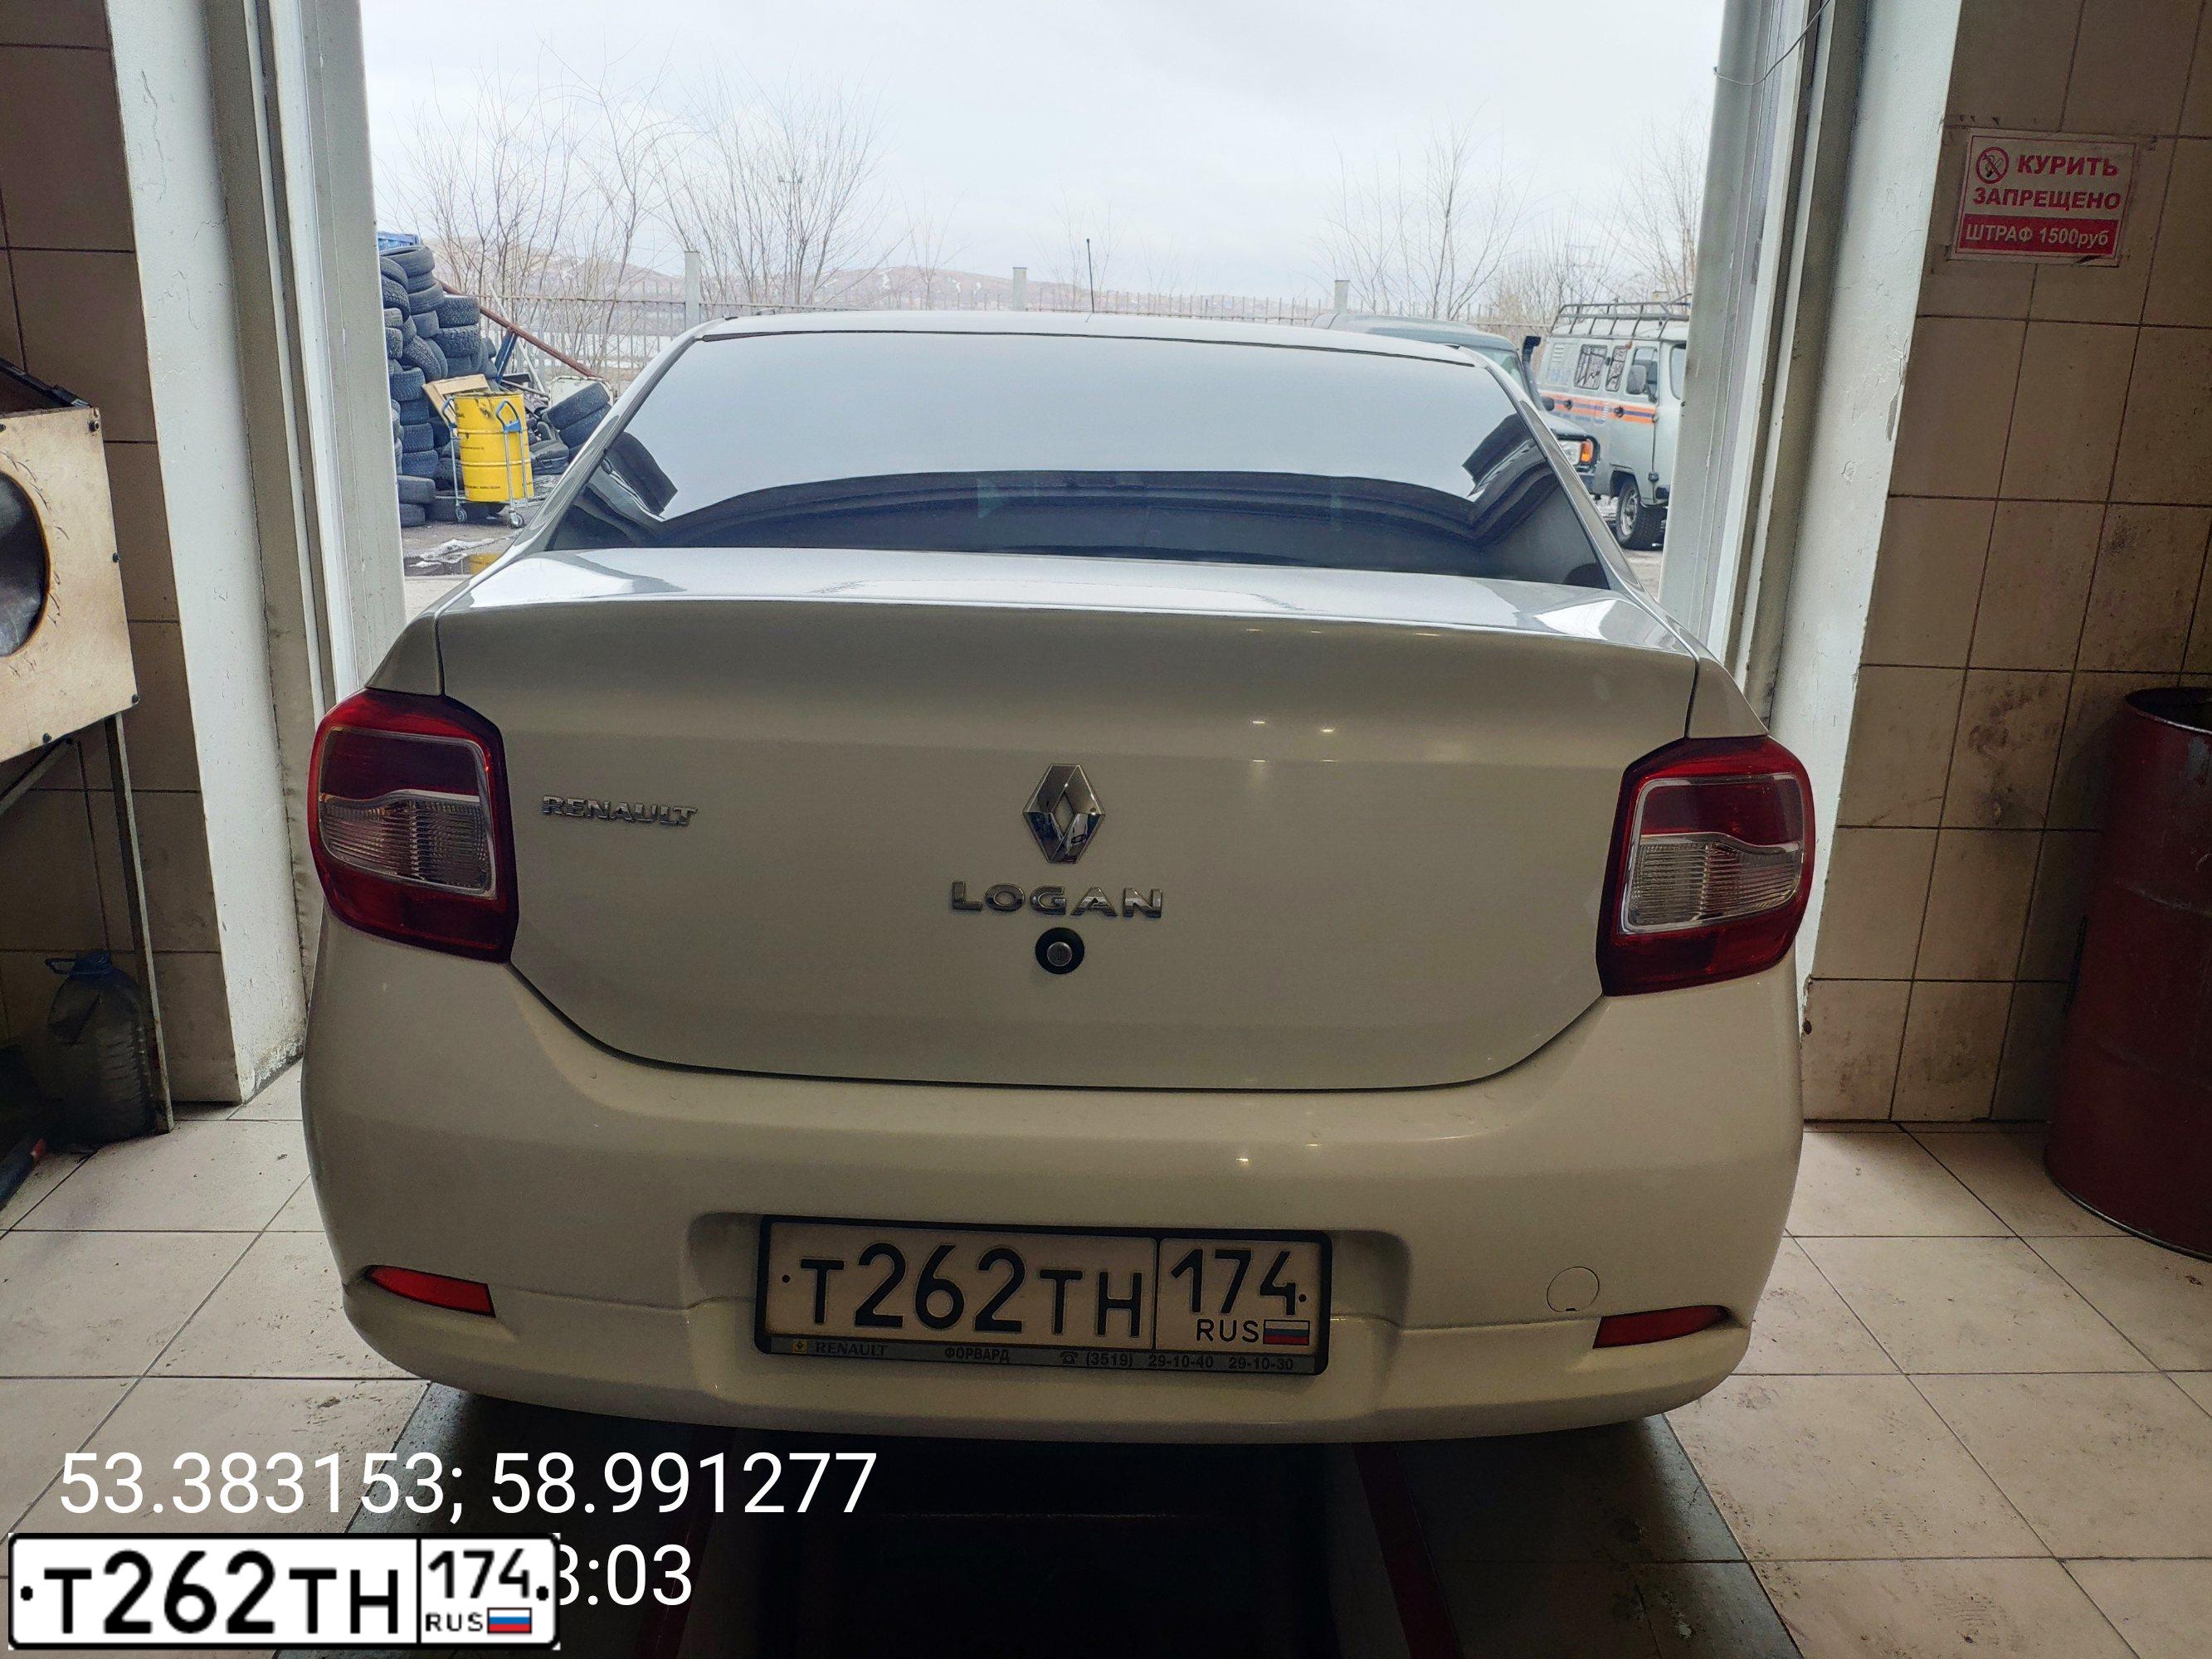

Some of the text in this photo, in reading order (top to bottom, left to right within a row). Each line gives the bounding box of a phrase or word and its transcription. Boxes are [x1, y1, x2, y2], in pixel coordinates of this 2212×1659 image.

[2017, 154, 2118, 177] КУРИТЬ
[1973, 187, 2122, 211] ЗАПРЕЩЕНО
[1966, 223, 2109, 249] ШТРАФ 1500руб
[542, 795, 698, 827] RENAULT
[952, 881, 1162, 918] LOGAN
[800, 1242, 1297, 1338] Т262ТН 174
[1196, 1318, 1259, 1343] RUS
[815, 1340, 889, 1358] RENAULT
[944, 1346, 1011, 1364] ФОРВАРД
